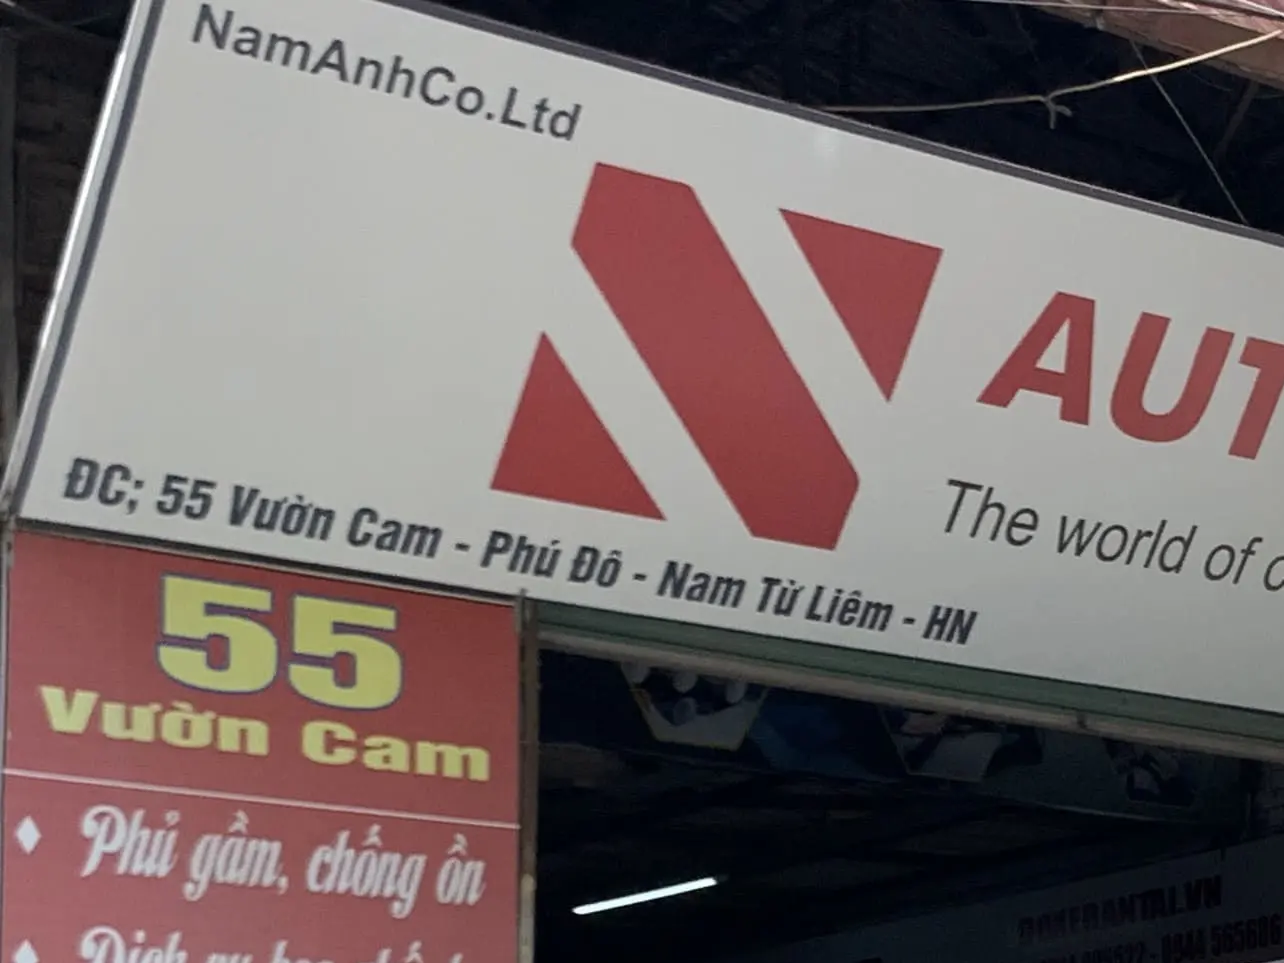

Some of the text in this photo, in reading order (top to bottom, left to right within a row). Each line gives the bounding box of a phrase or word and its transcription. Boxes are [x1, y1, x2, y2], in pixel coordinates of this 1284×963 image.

[191, 3, 582, 141] NamAnhCo.Ltd
[156, 473, 217, 520] 55
[227, 484, 335, 541] Vườn
[346, 507, 443, 558] Cam
[480, 529, 562, 577] Phú
[567, 544, 623, 588] Đô
[656, 560, 747, 608] Nam
[756, 576, 805, 617] Từ
[805, 584, 894, 632] Liêm
[922, 604, 978, 645] HN
[943, 478, 1039, 548] The
[1056, 513, 1197, 575] world
[1203, 537, 1263, 585] of
[156, 573, 404, 711] 55
[37, 684, 490, 783] Vườn Cam
[80, 803, 180, 879] Phủ
[305, 824, 428, 920] chống
[435, 833, 487, 906] ồn
